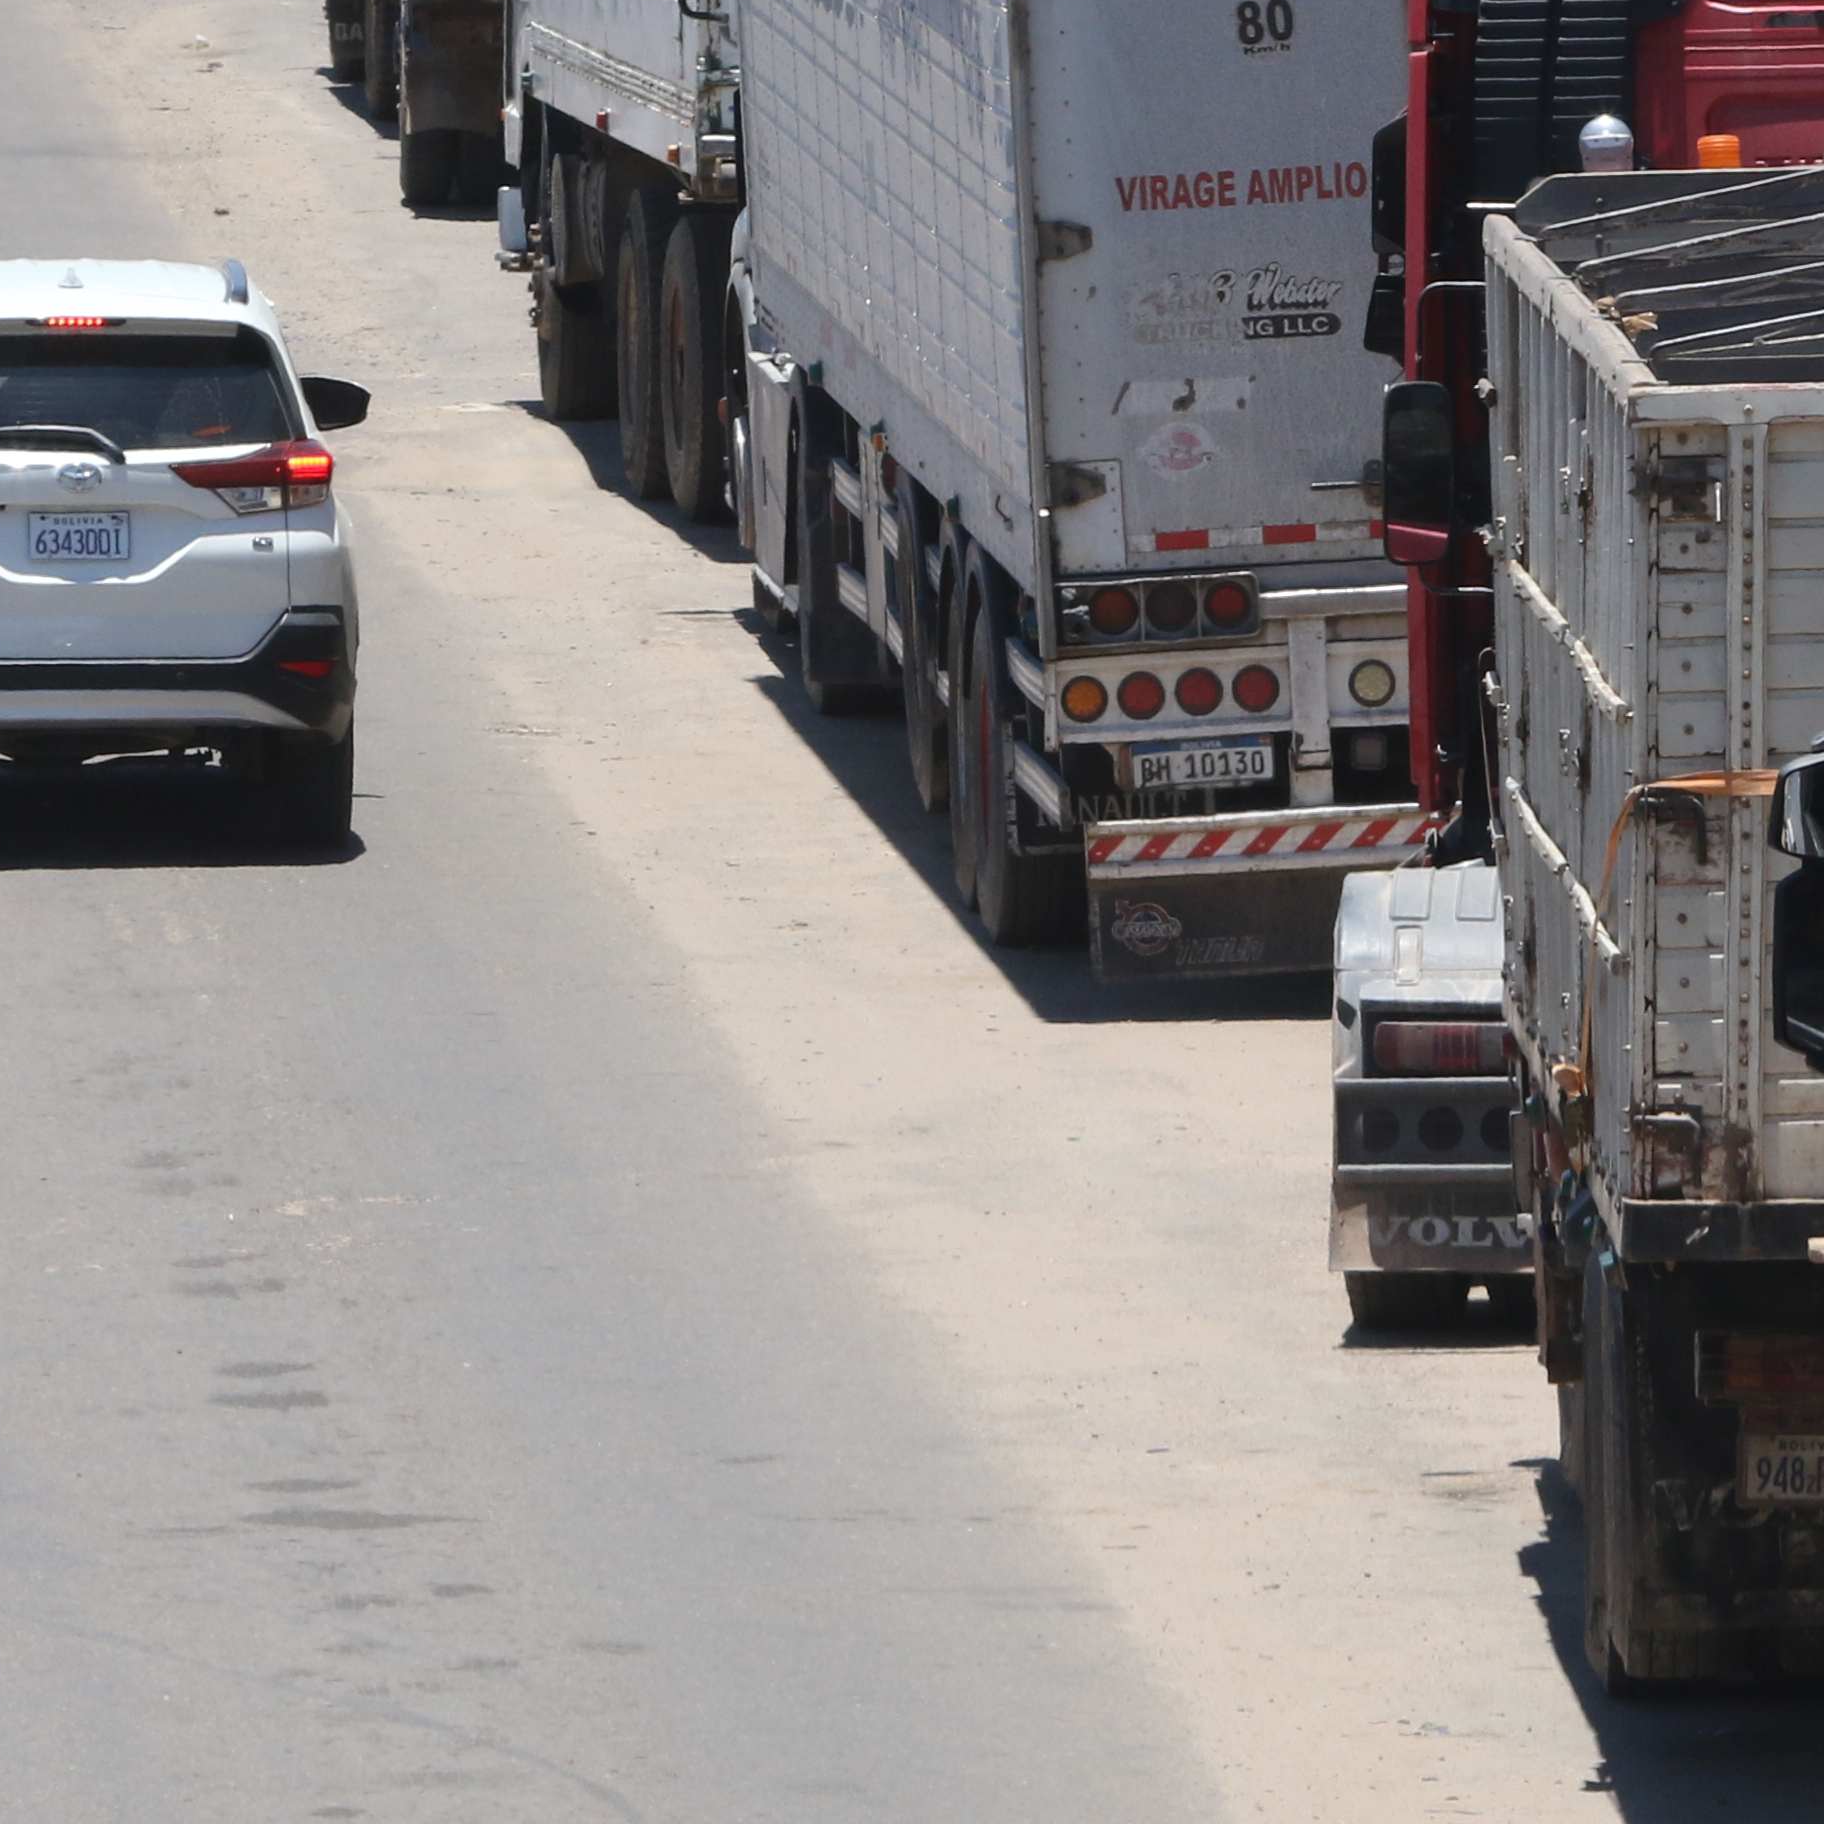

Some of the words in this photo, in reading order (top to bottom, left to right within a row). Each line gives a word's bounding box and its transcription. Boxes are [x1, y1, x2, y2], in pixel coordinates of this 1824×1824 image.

[1115, 170, 1236, 212] VIRAGE
[1247, 161, 1367, 205] AMPLIO
[1284, 316, 1330, 334] LLC
[35, 528, 121, 556] 6343DDI
[1185, 750, 1265, 779] 10130
